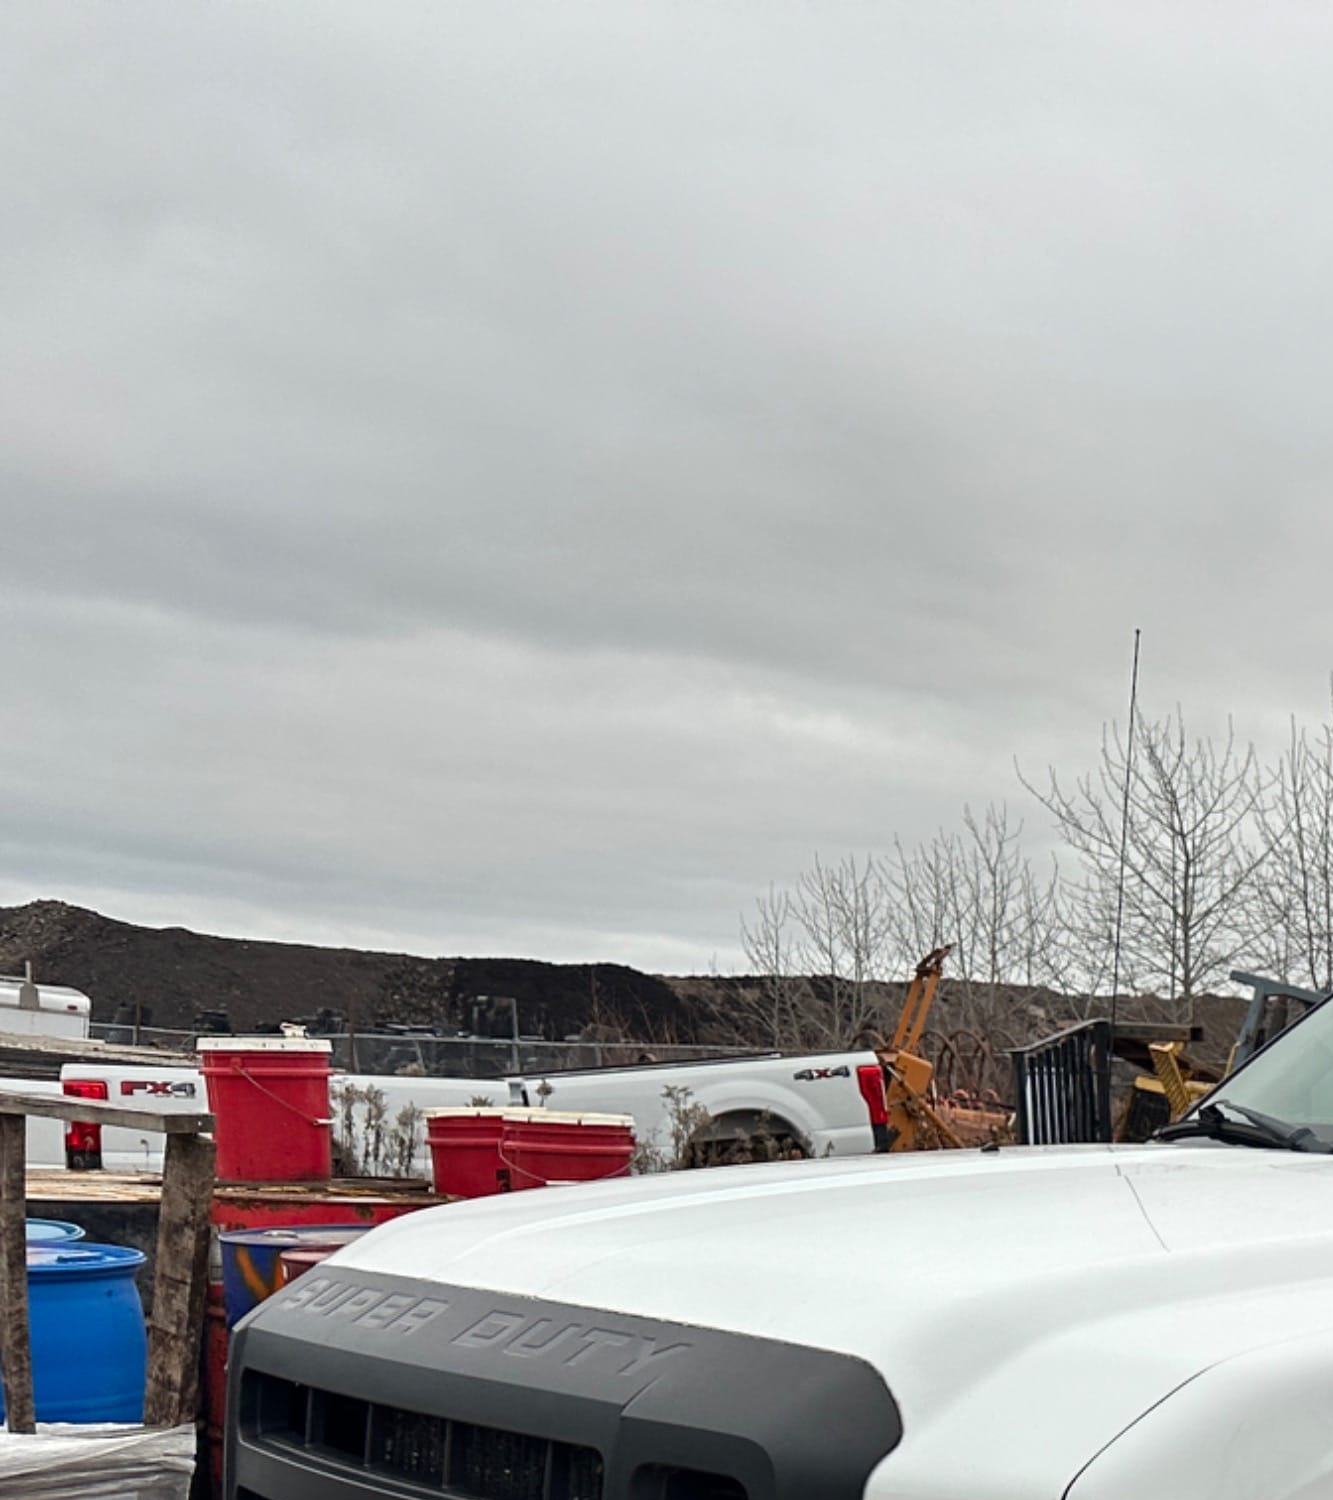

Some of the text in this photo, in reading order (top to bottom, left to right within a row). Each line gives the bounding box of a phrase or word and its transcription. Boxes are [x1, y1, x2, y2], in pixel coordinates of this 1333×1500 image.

[120, 1081, 197, 1098] FX4
[277, 1276, 697, 1377] SUPER DUTY
